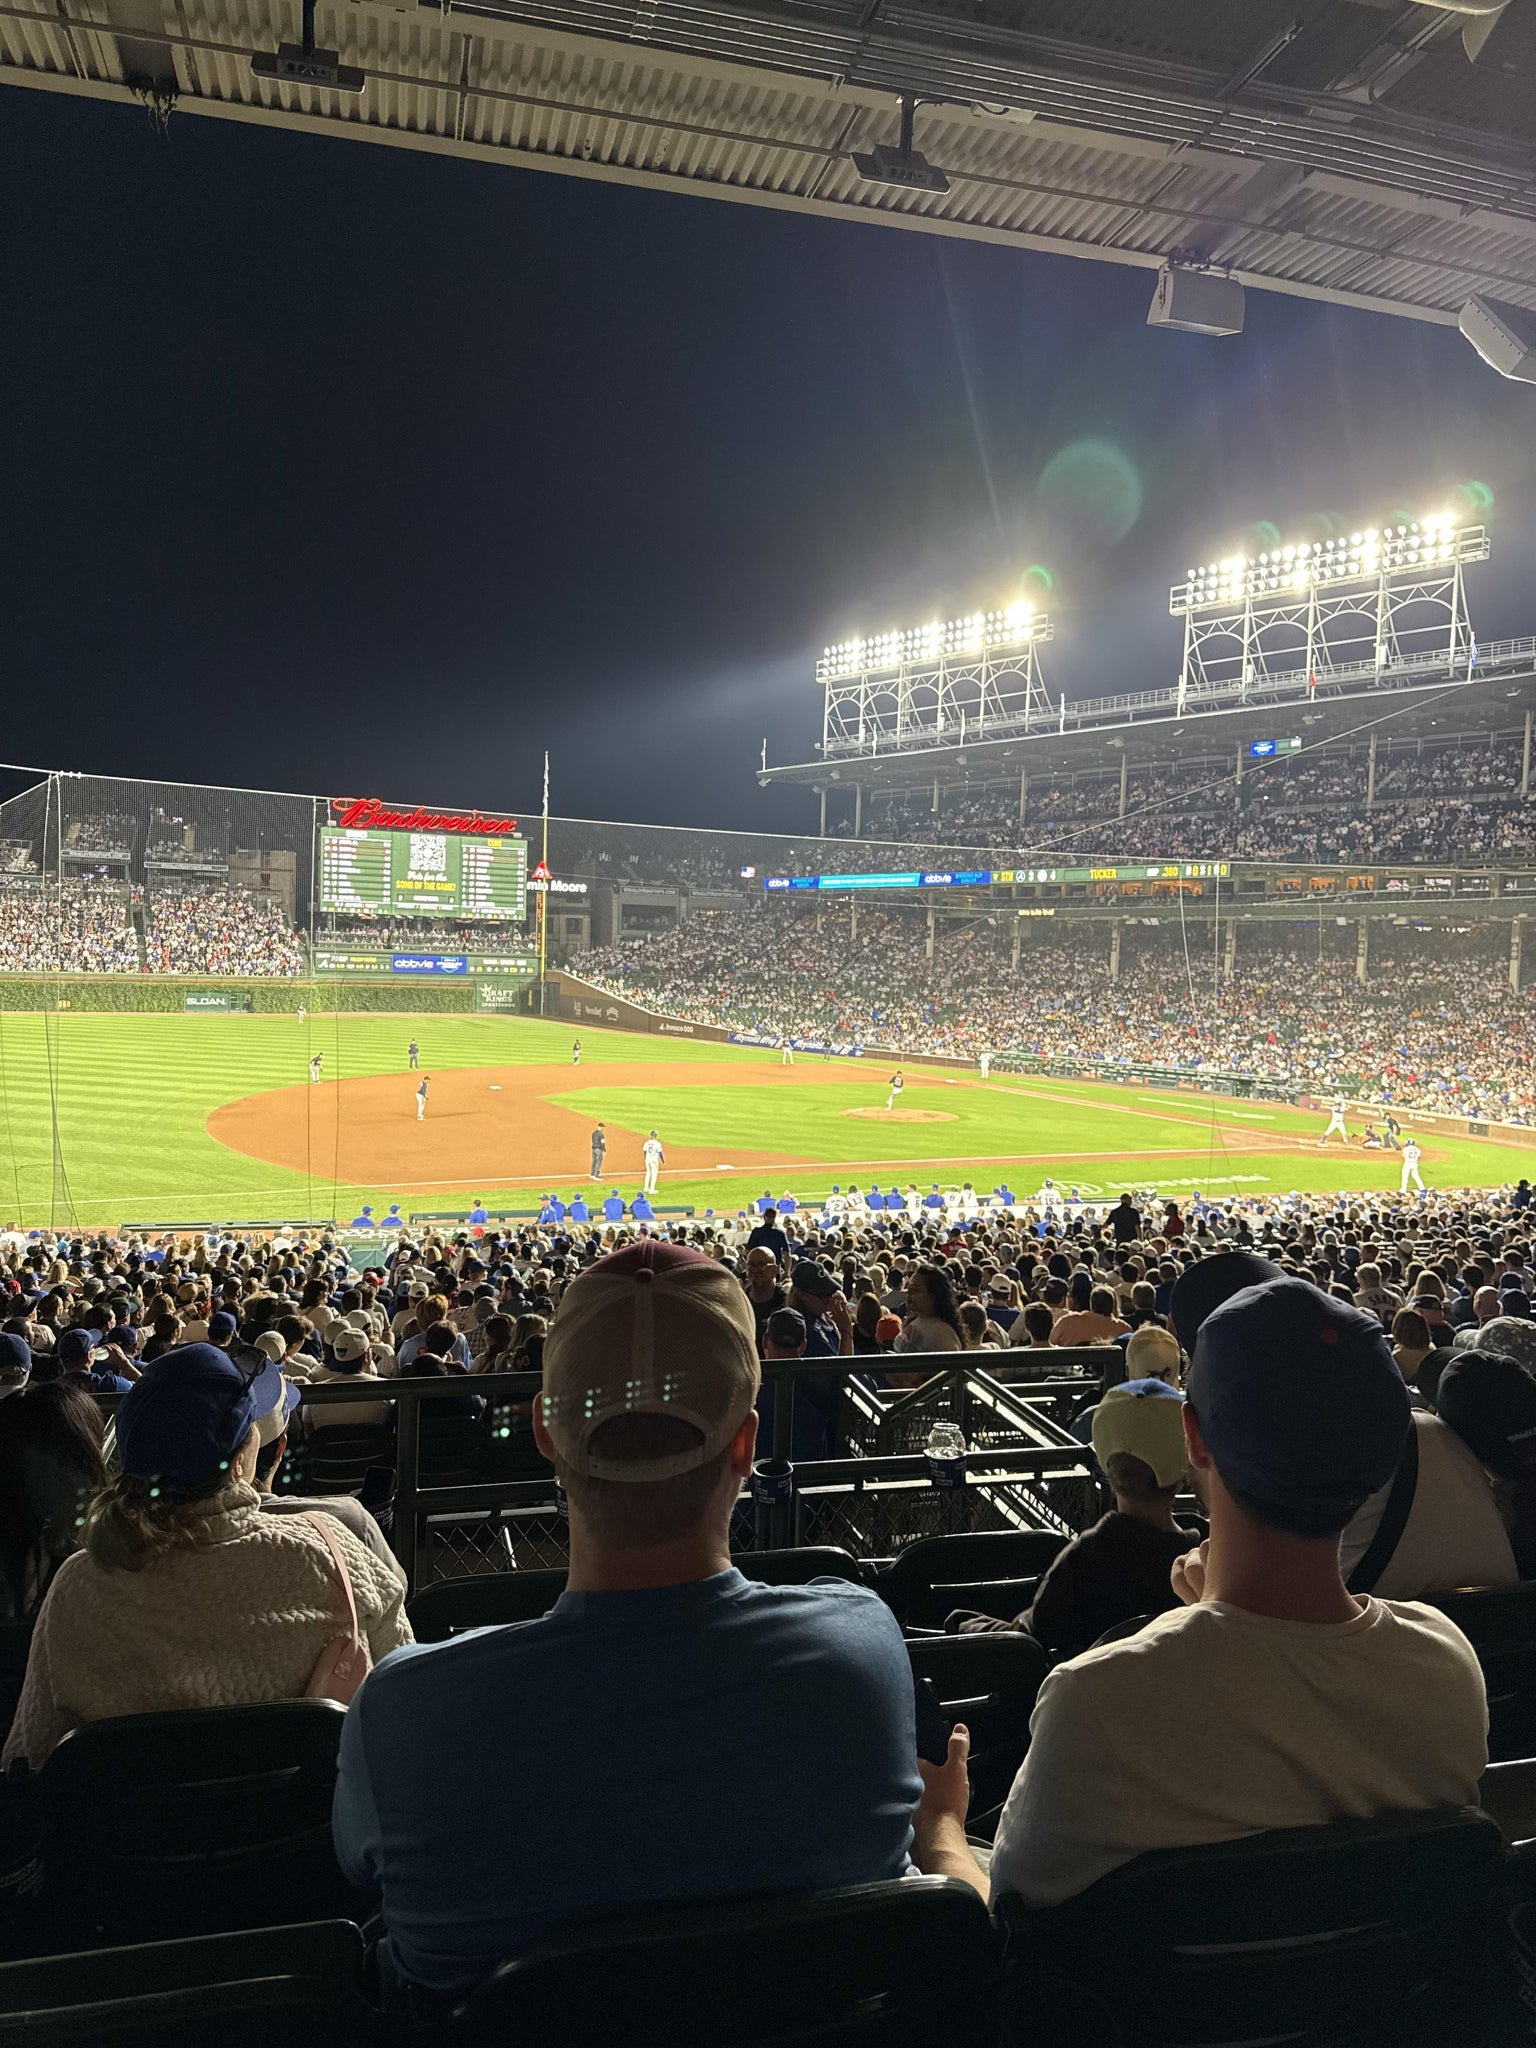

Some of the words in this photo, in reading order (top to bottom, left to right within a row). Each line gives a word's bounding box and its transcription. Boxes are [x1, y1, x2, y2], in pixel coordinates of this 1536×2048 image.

[333, 798, 517, 834] Budweiser
[1090, 868, 1117, 879] TUCKER
[923, 874, 952, 884] abbvie
[414, 881, 423, 889] OF
[424, 881, 436, 890] THE
[550, 879, 587, 893] Moore
[394, 958, 434, 969] abbvie
[481, 990, 514, 998] DRAFT
[186, 997, 226, 1005] SLOAN
[853, 1197, 863, 1205] 13
[1045, 1197, 1054, 1205] 15
[833, 1203, 840, 1211] 2
